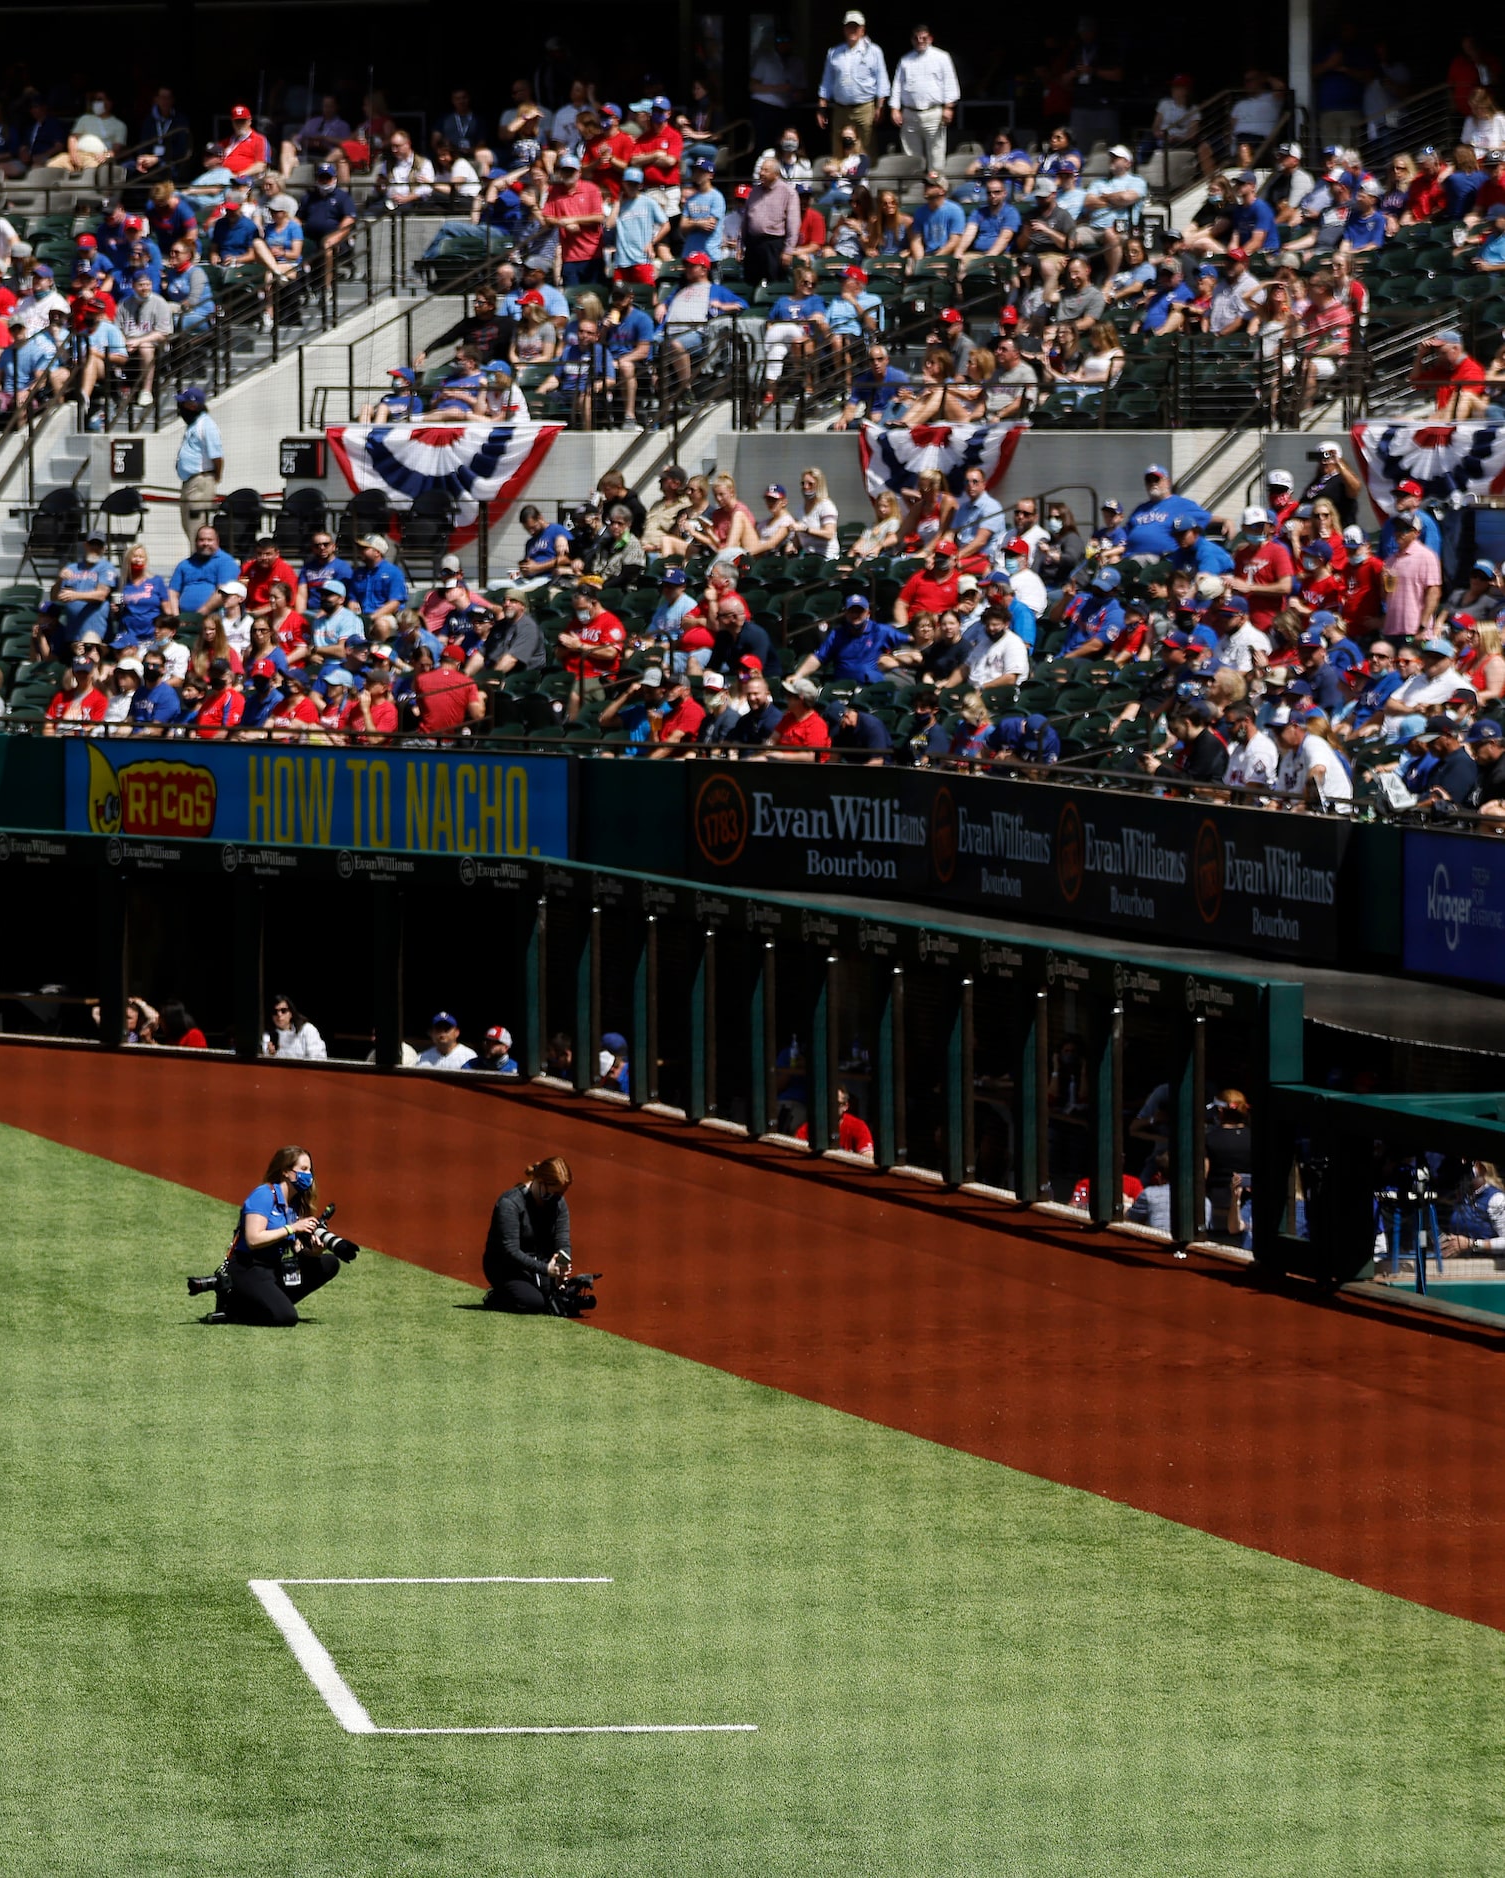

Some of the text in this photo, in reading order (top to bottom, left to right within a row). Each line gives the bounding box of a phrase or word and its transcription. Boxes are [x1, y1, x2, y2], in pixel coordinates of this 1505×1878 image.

[248, 755, 540, 856] HOW TO NACHO.
[703, 808, 740, 848] 1783
[806, 850, 898, 880] Bourbon
[981, 867, 1022, 898] Bourbon
[1110, 885, 1156, 920] Bourbon
[1426, 862, 1473, 951] Kroger
[1251, 906, 1300, 941] Bourbon
